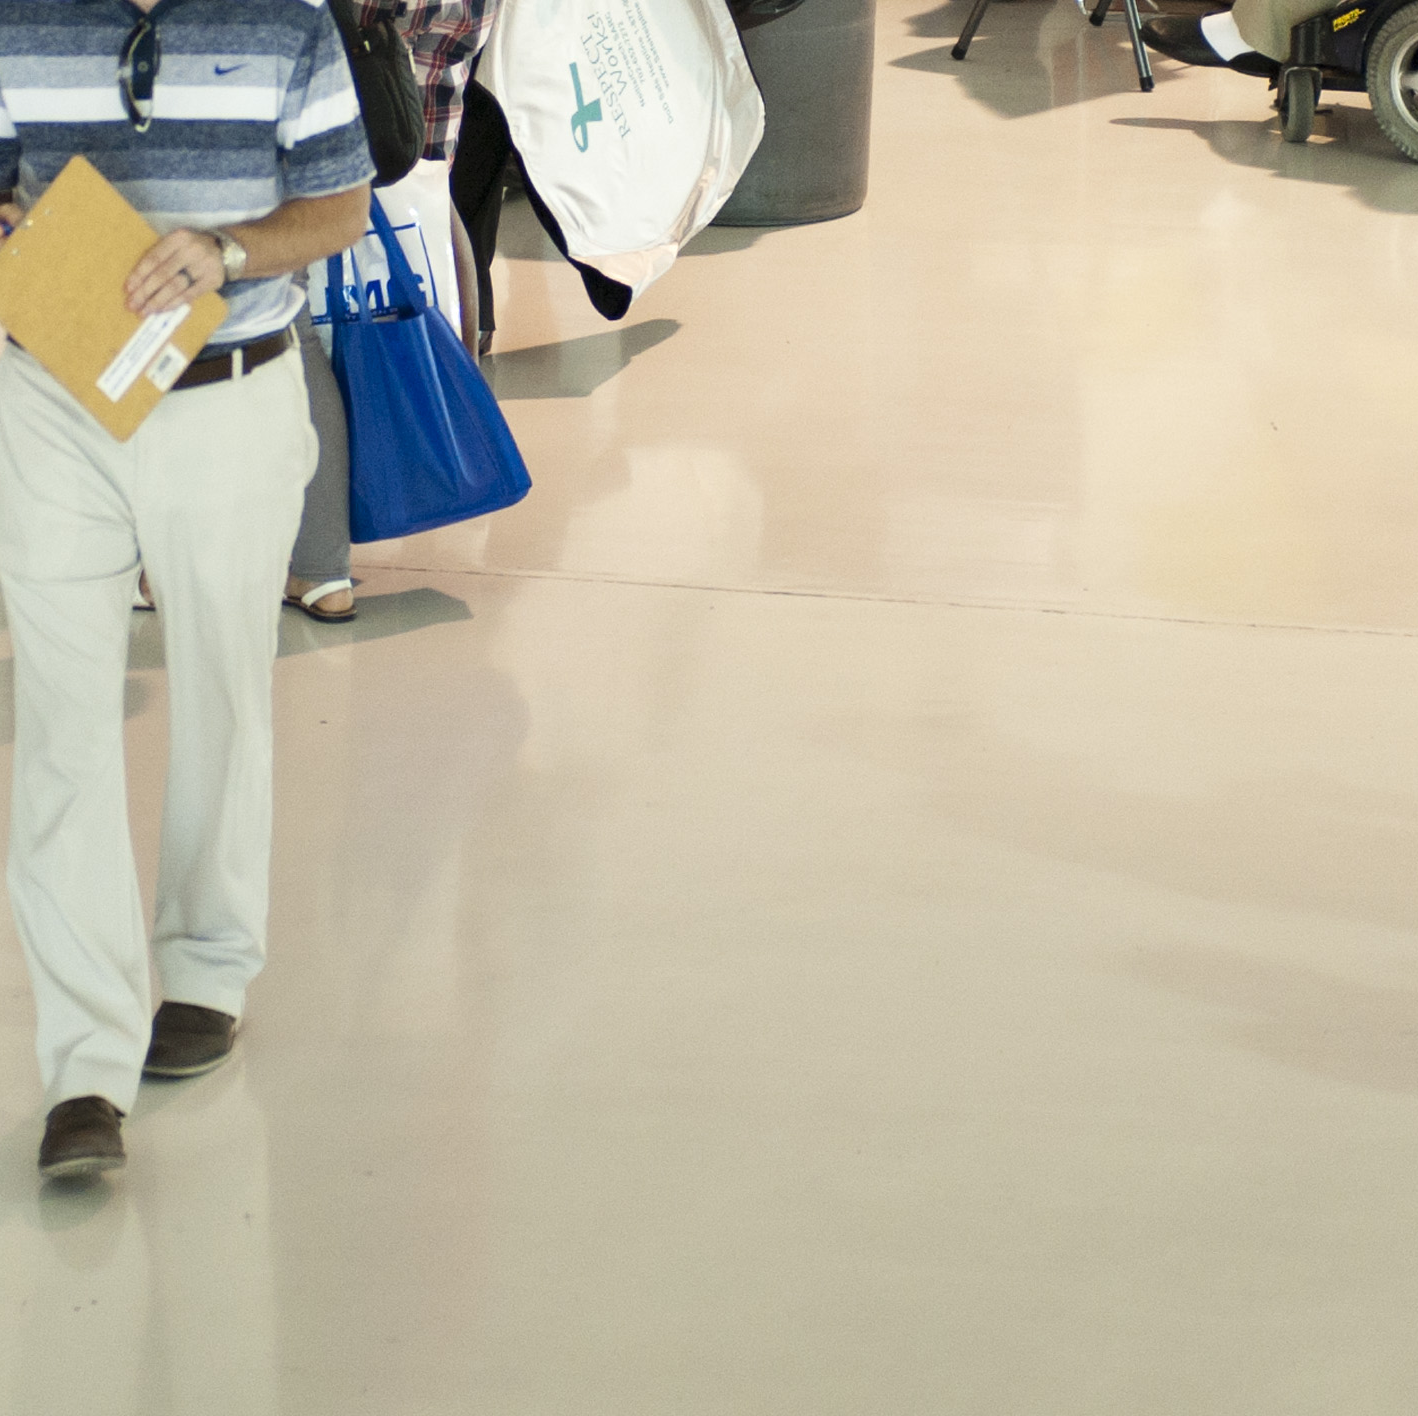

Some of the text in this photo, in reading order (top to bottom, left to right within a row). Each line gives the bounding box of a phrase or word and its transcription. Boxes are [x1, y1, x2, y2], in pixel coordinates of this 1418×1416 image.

[605, 11, 620, 42] SARC
[587, 11, 628, 95] Works!
[638, 37, 656, 77] Helpline
[581, 34, 631, 139] RESPECT
[654, 79, 665, 101] Safe
[662, 101, 674, 124] DoD
